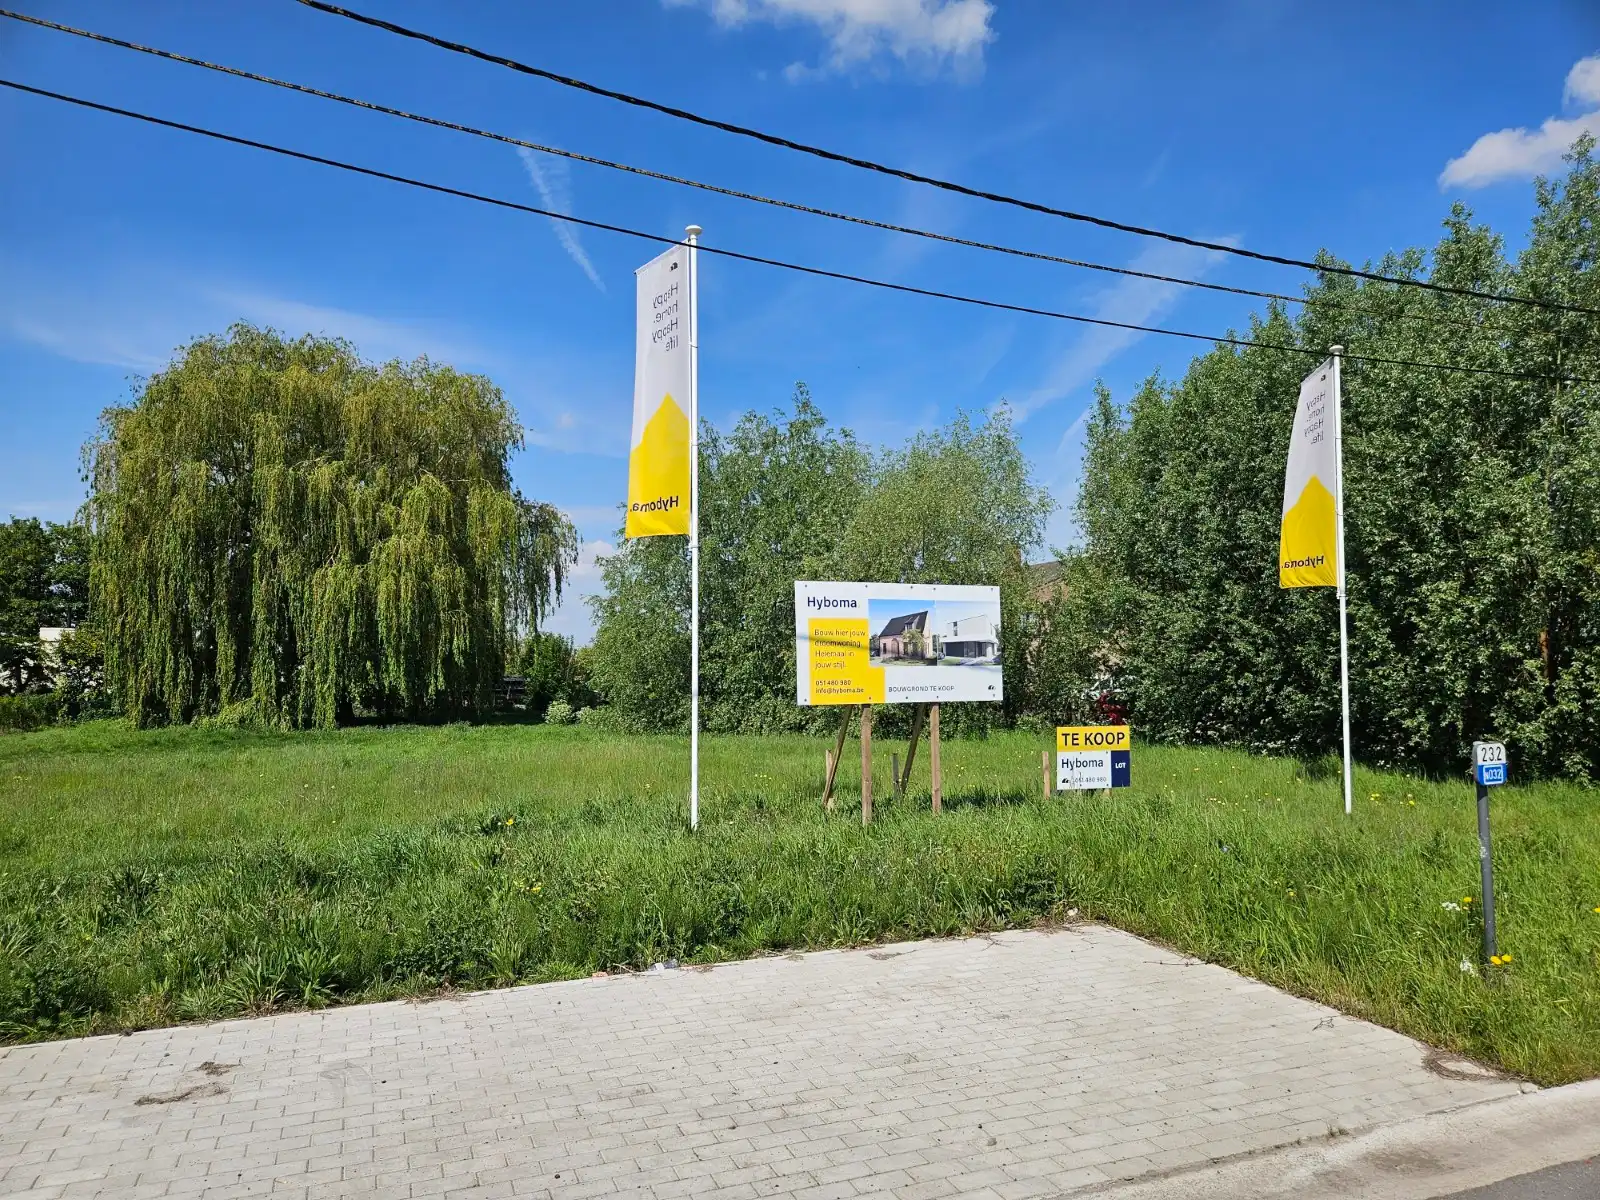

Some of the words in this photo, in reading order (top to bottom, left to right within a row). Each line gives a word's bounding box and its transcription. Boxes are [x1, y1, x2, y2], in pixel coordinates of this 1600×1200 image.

[849, 629, 866, 638] jouw
[815, 661, 832, 670] jouw
[1061, 732, 1080, 746] TE
[1084, 732, 1125, 746] KOOP
[1061, 758, 1104, 771] Hyboma
